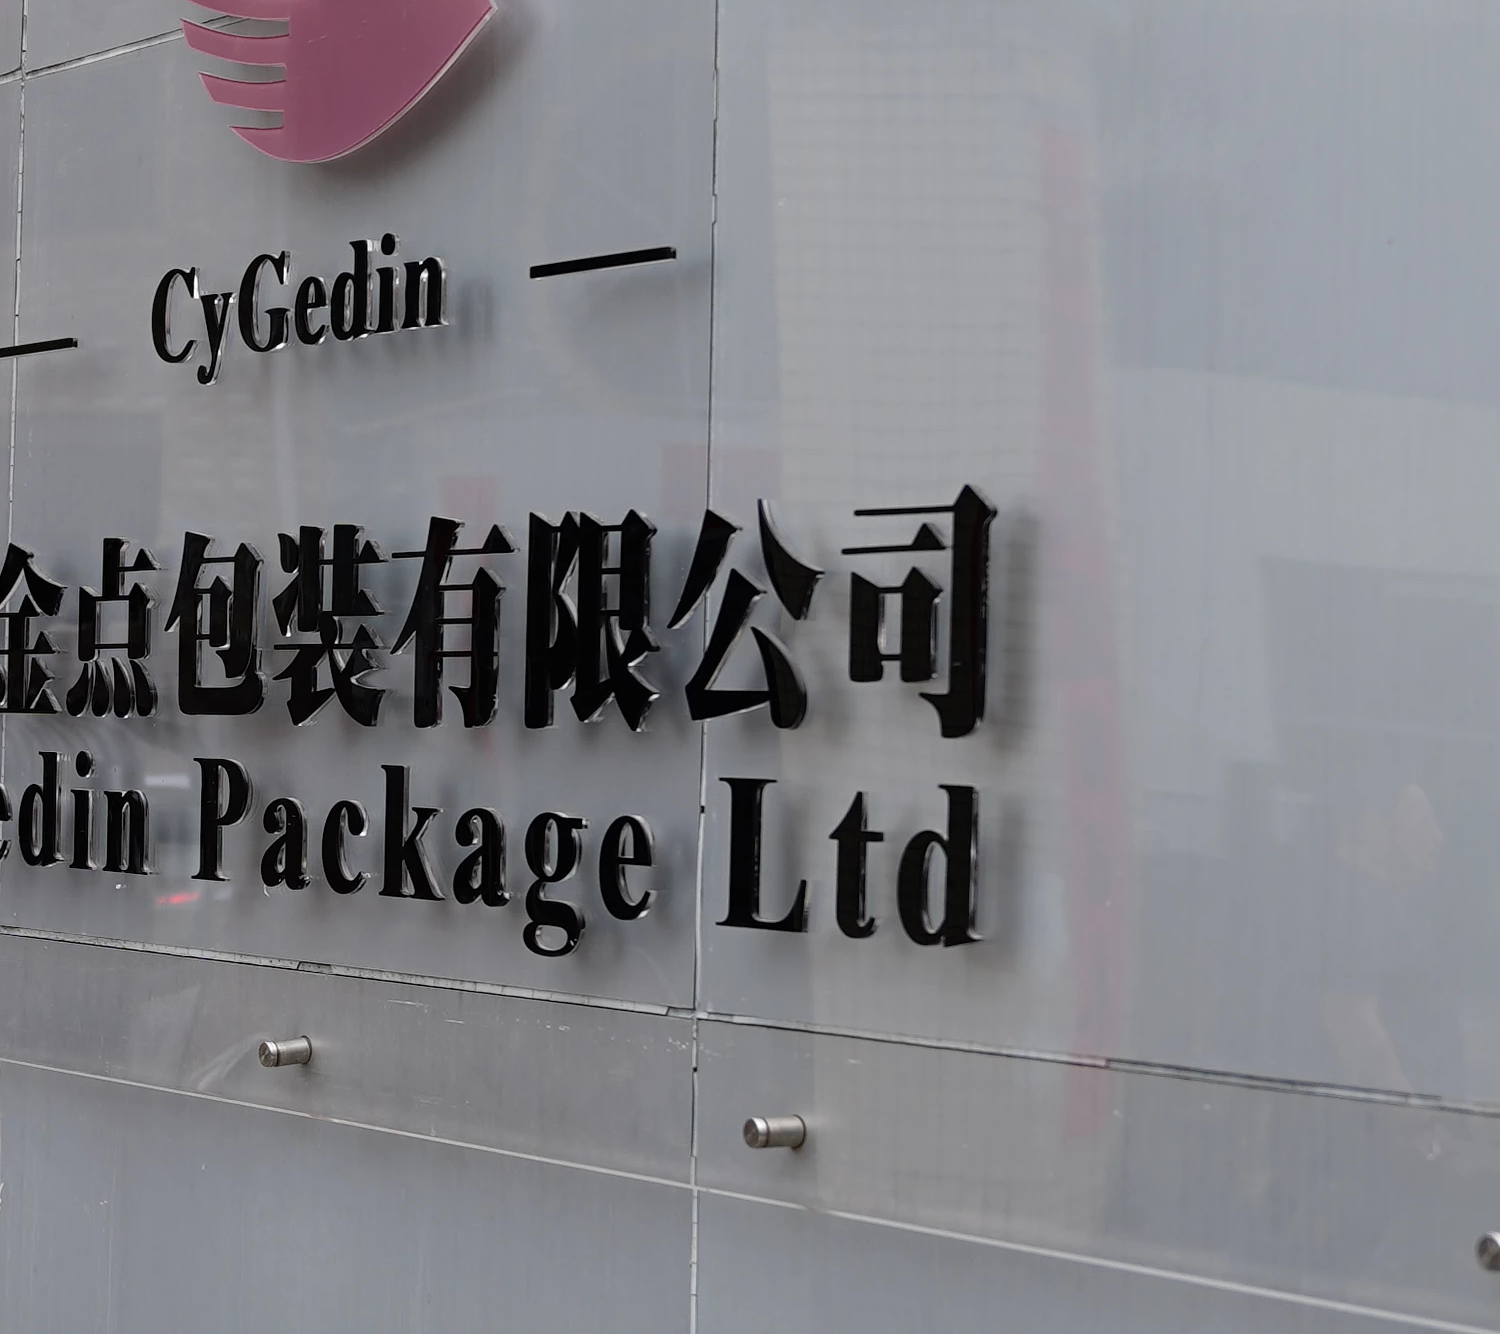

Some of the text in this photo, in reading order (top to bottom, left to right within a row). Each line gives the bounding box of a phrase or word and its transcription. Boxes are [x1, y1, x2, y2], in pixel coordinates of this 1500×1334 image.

[152, 233, 447, 384] CyGedin
[191, 757, 656, 957] Package
[716, 777, 980, 948] Ltd
